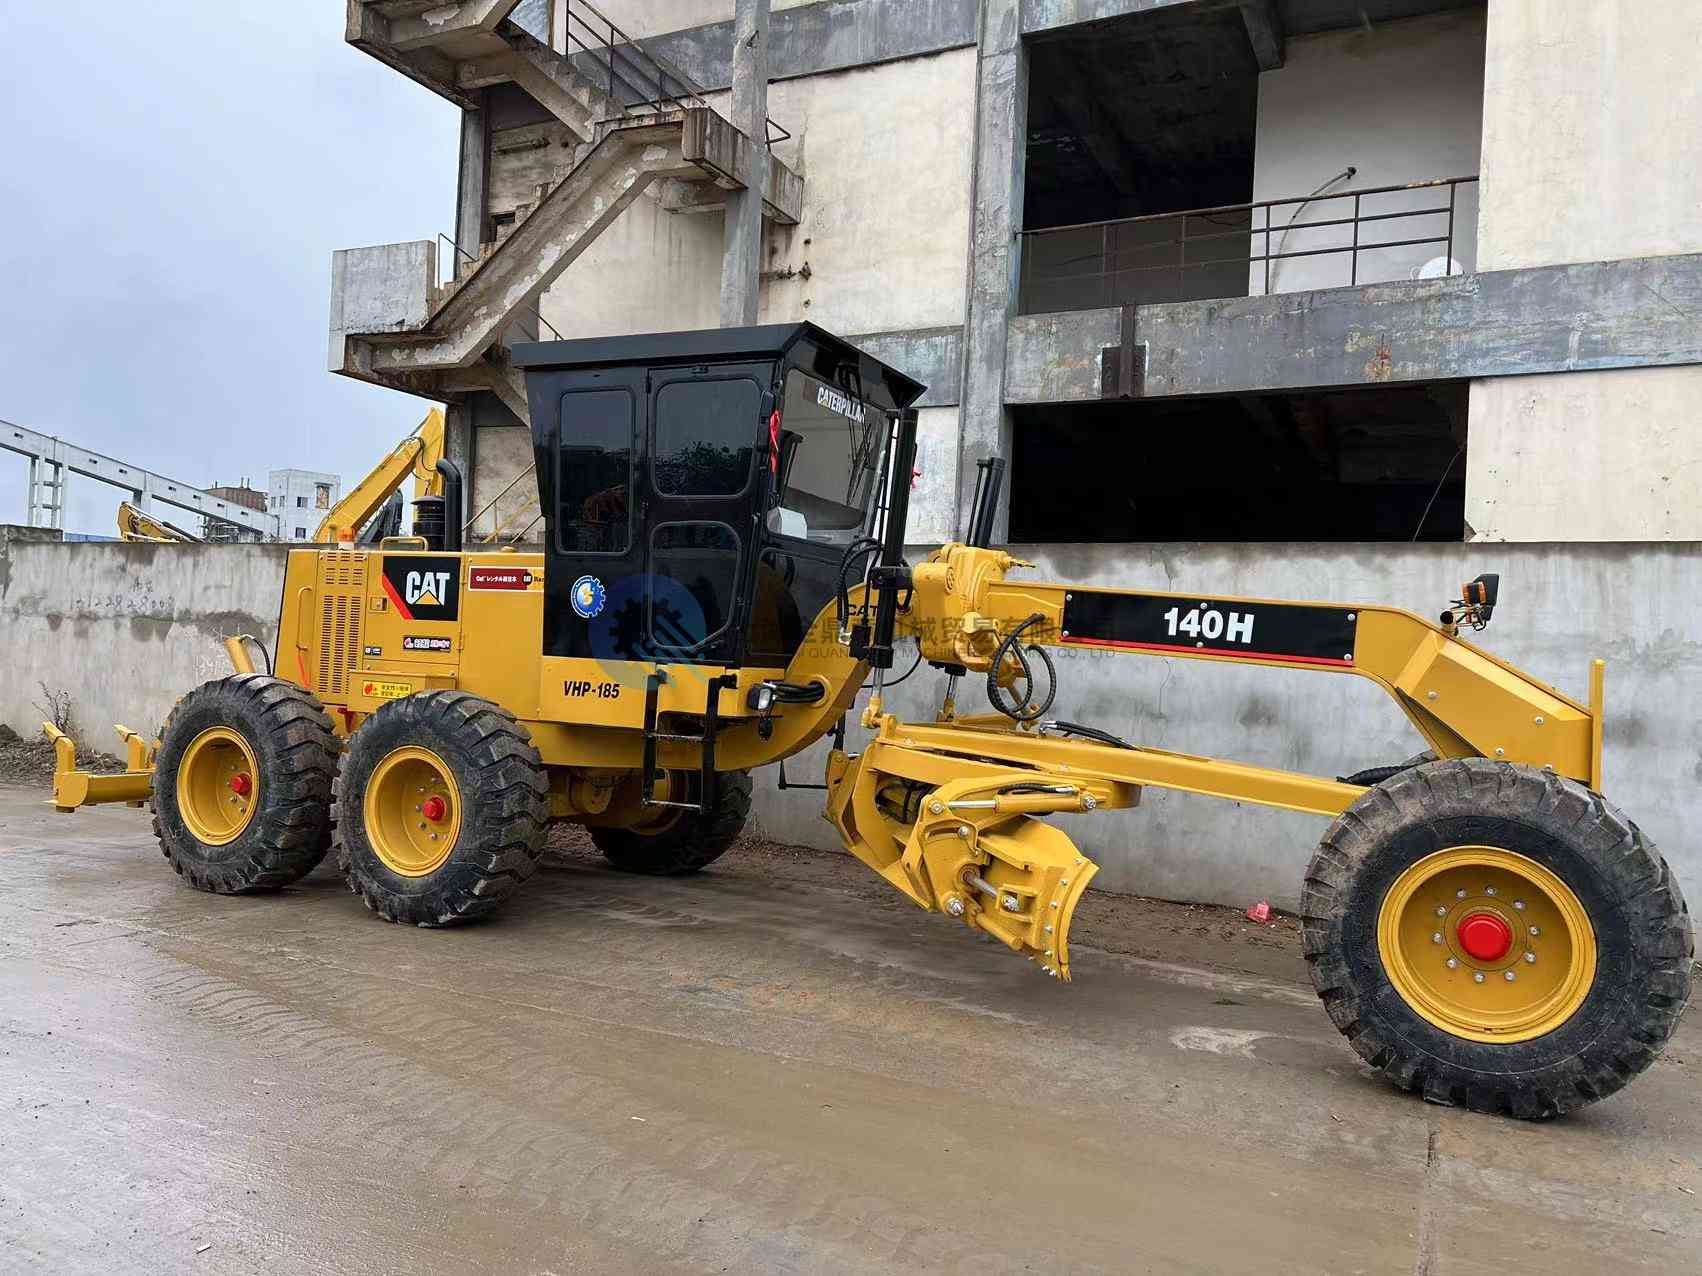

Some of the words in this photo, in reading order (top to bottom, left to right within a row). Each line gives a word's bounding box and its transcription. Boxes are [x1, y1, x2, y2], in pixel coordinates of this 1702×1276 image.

[405, 571, 451, 606] CAT
[1163, 606, 1255, 643] 140H
[563, 680, 620, 698] VHP-185
